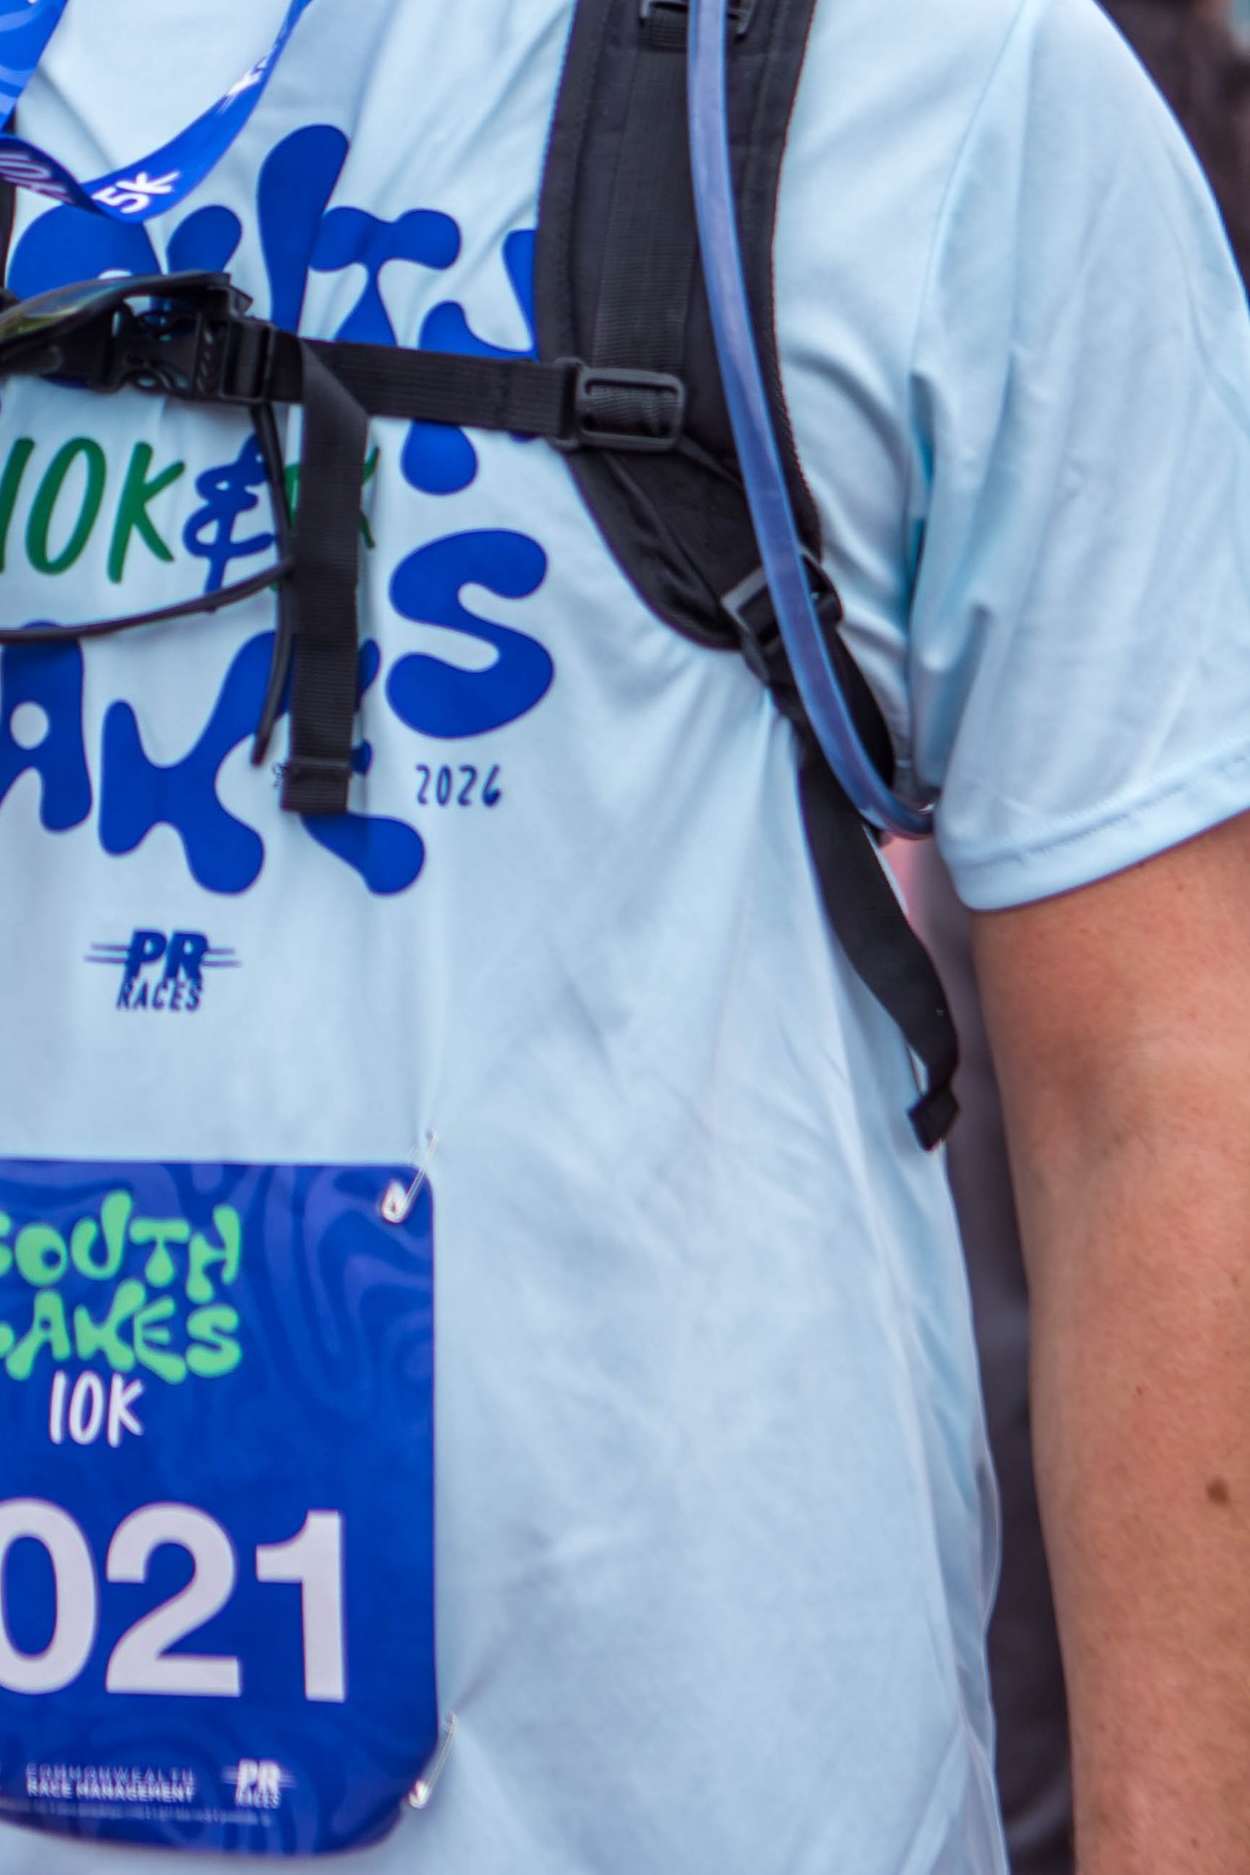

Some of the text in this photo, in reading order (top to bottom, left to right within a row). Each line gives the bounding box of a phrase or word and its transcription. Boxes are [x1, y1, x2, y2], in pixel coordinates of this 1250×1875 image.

[90, 170, 181, 215] 5K
[415, 763, 503, 808] 2026
[124, 928, 210, 980] PR
[116, 978, 203, 1012] RACES
[50, 1370, 145, 1448] 10K
